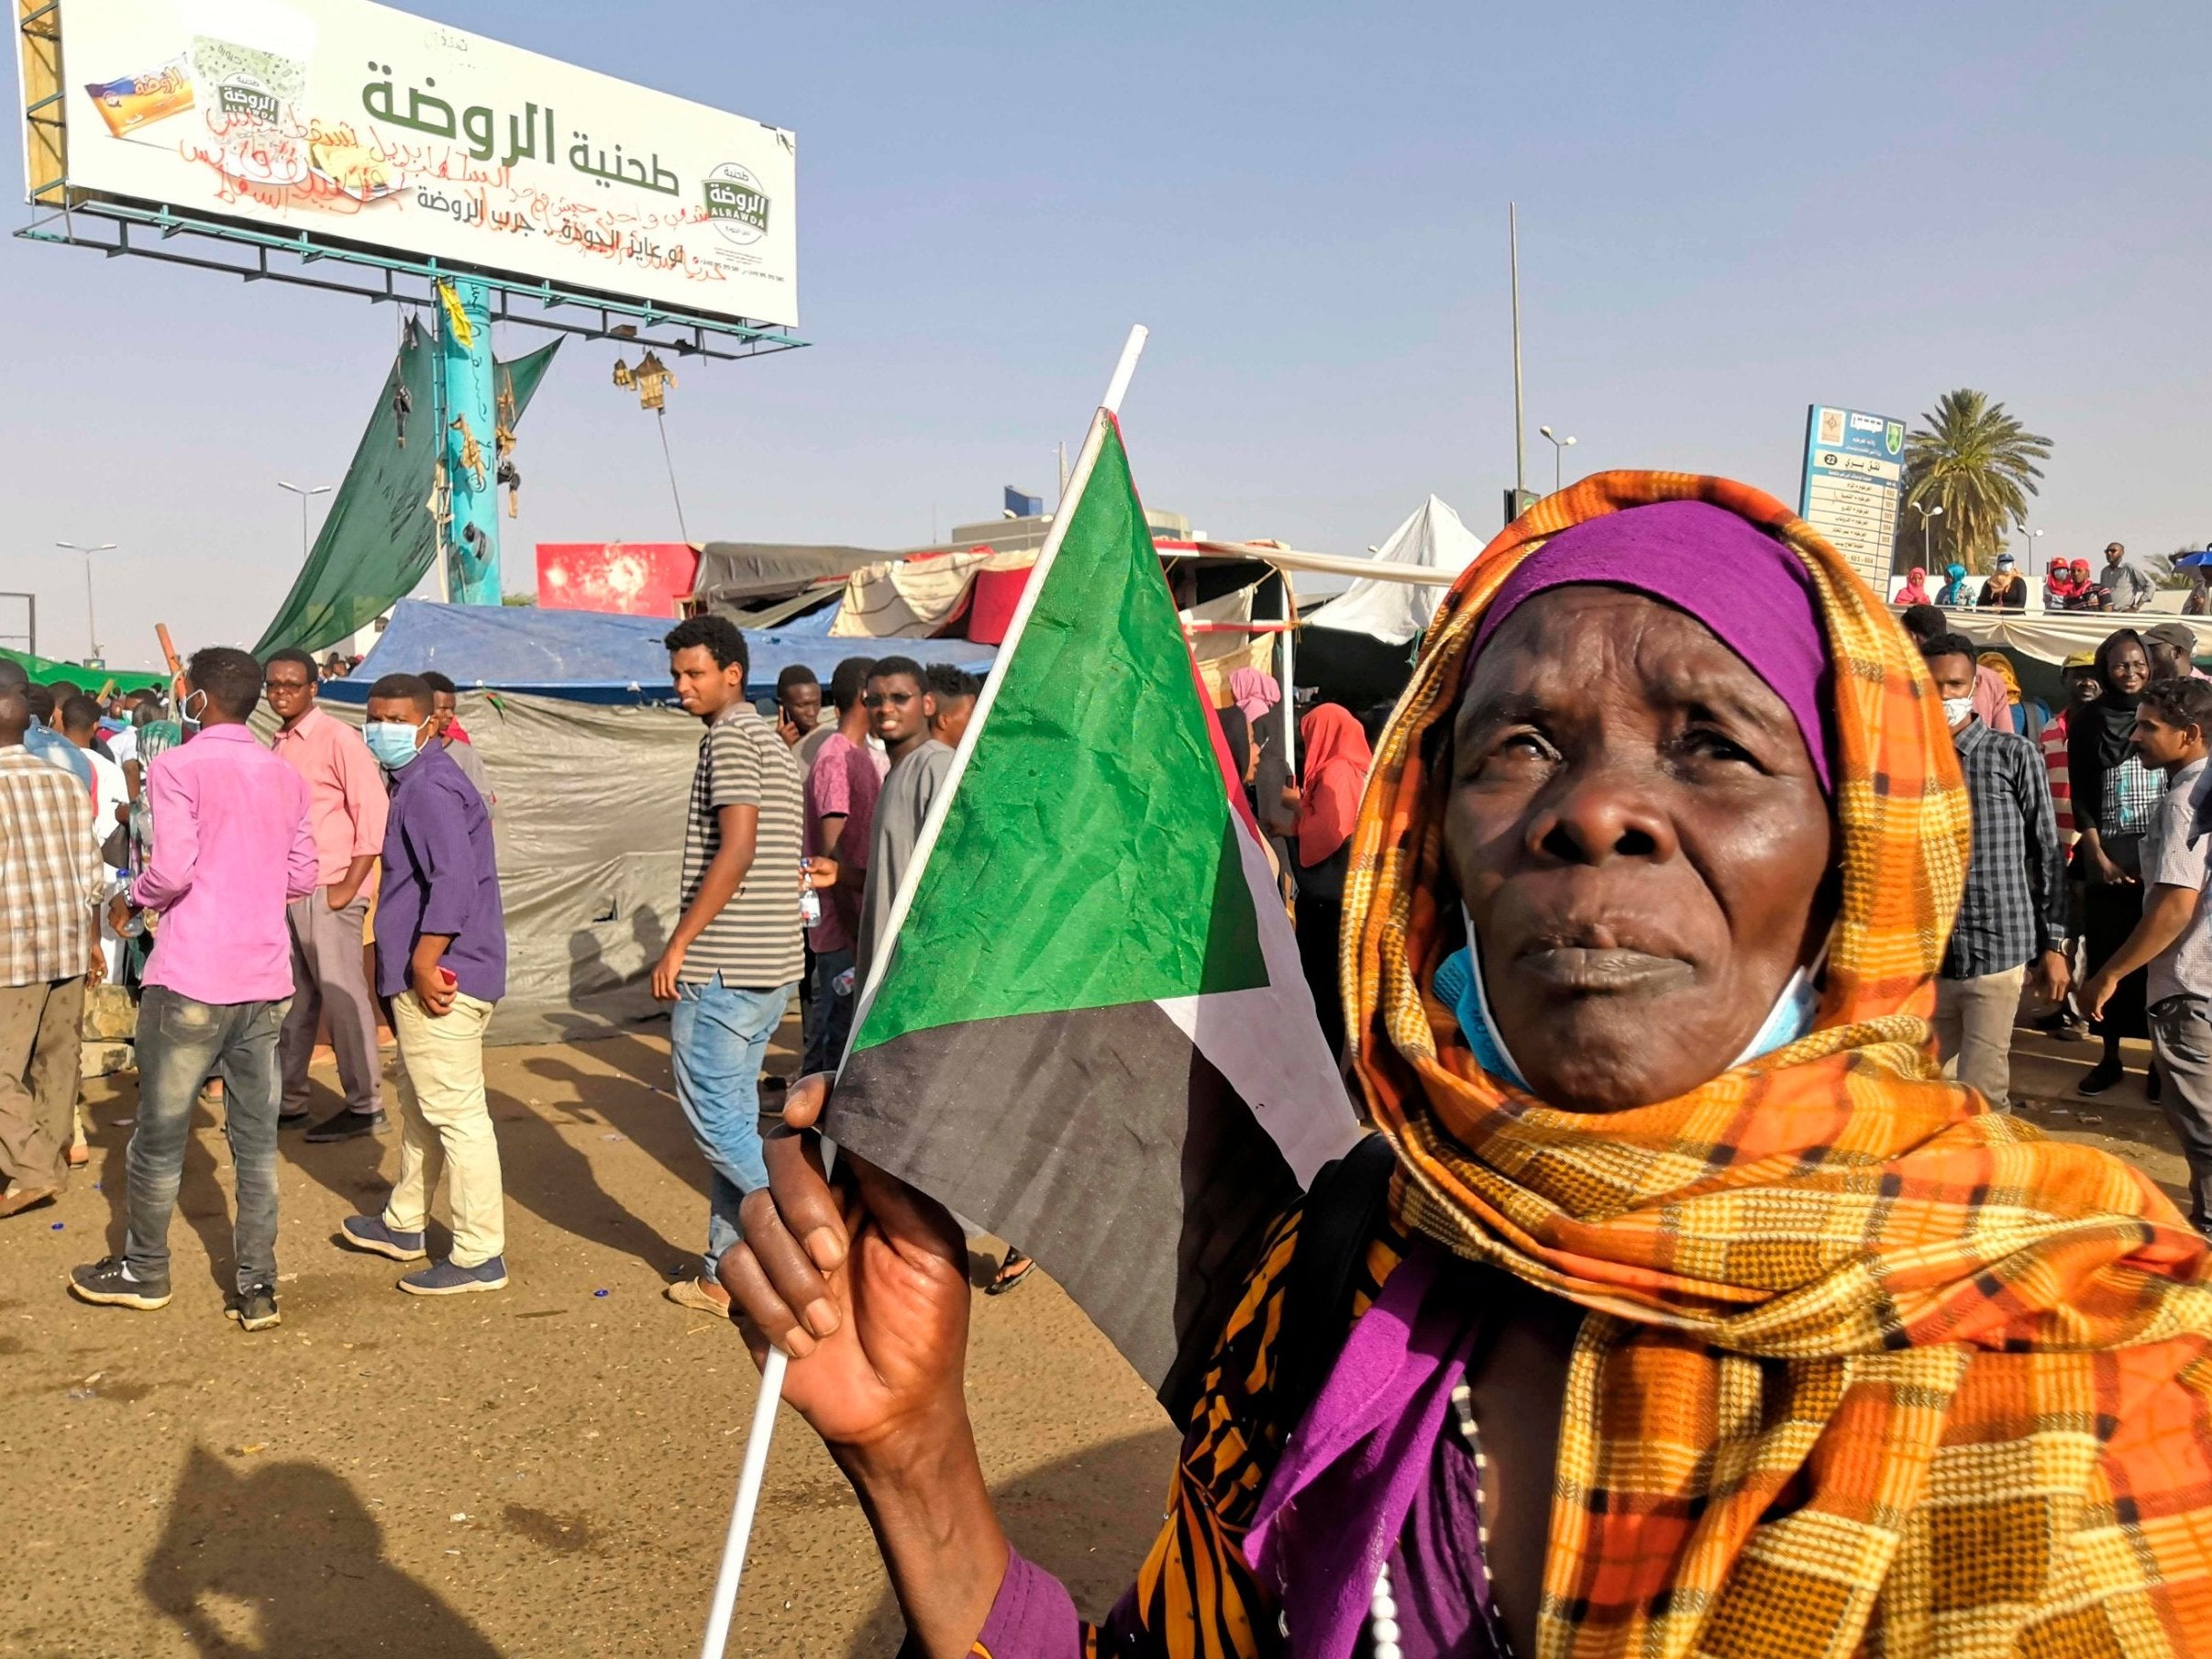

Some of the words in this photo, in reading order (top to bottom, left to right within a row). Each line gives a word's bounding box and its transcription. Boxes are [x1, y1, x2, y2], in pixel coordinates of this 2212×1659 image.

[224, 87, 275, 112] الروضة
[225, 104, 275, 121] ALRAWDA
[361, 61, 556, 168] الروضة
[569, 130, 680, 197] طحنية
[724, 166, 749, 182] طحنية
[417, 184, 484, 224] الروضة
[710, 182, 766, 215] الروضة
[491, 209, 536, 237] جرب
[711, 207, 765, 228] ALRAWDA
[1826, 456, 1836, 464] 22
